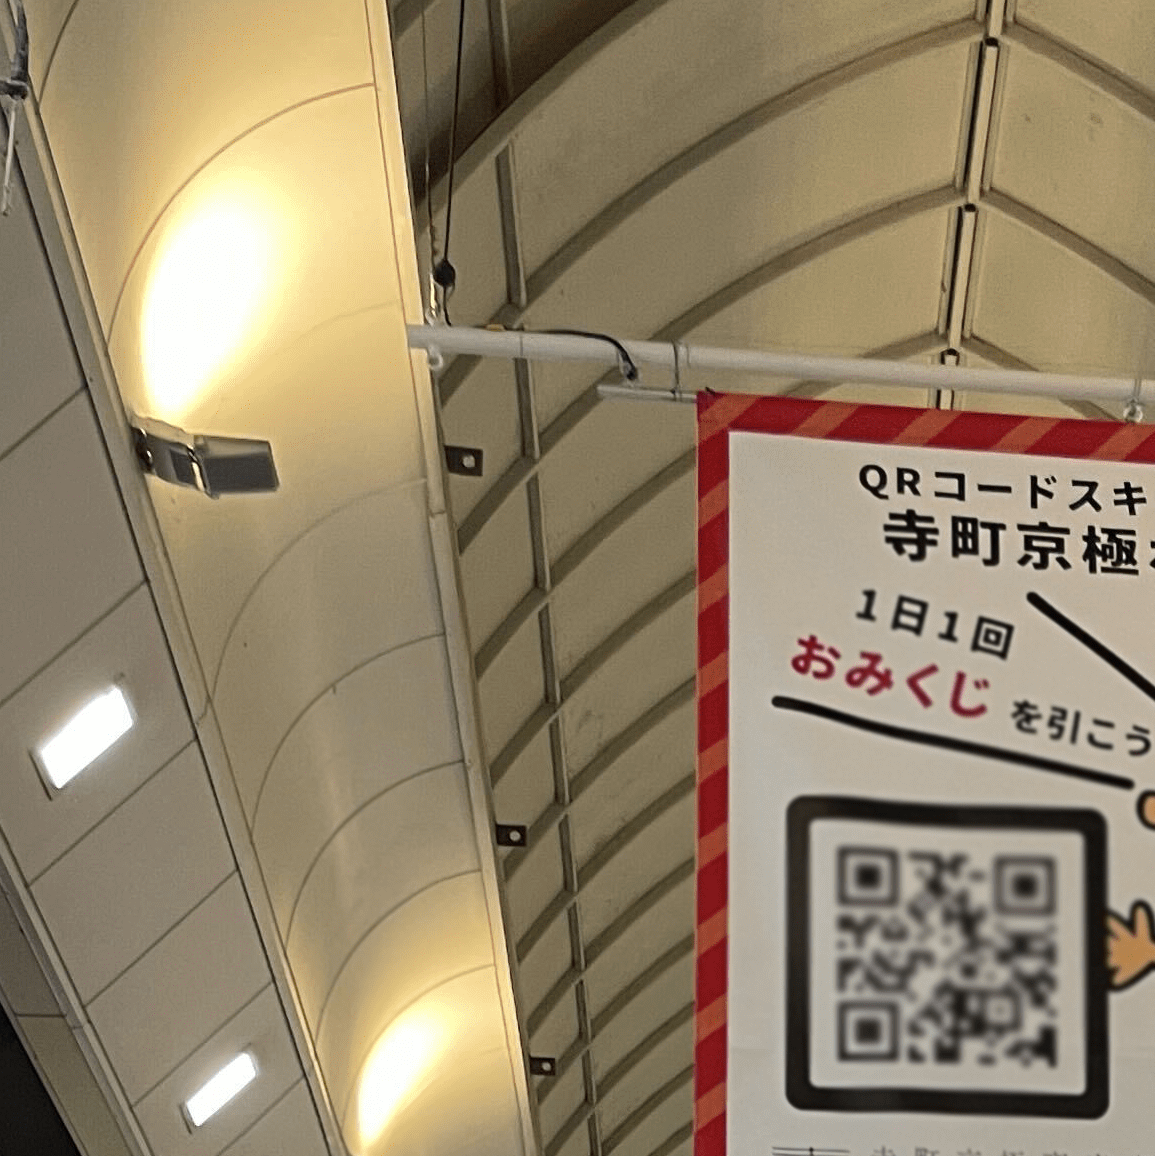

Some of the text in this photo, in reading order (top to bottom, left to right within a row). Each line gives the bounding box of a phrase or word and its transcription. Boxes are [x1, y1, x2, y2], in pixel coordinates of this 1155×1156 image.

[855, 589, 1015, 660] 1日1回
[792, 636, 1153, 757] おみくじ を引こう
